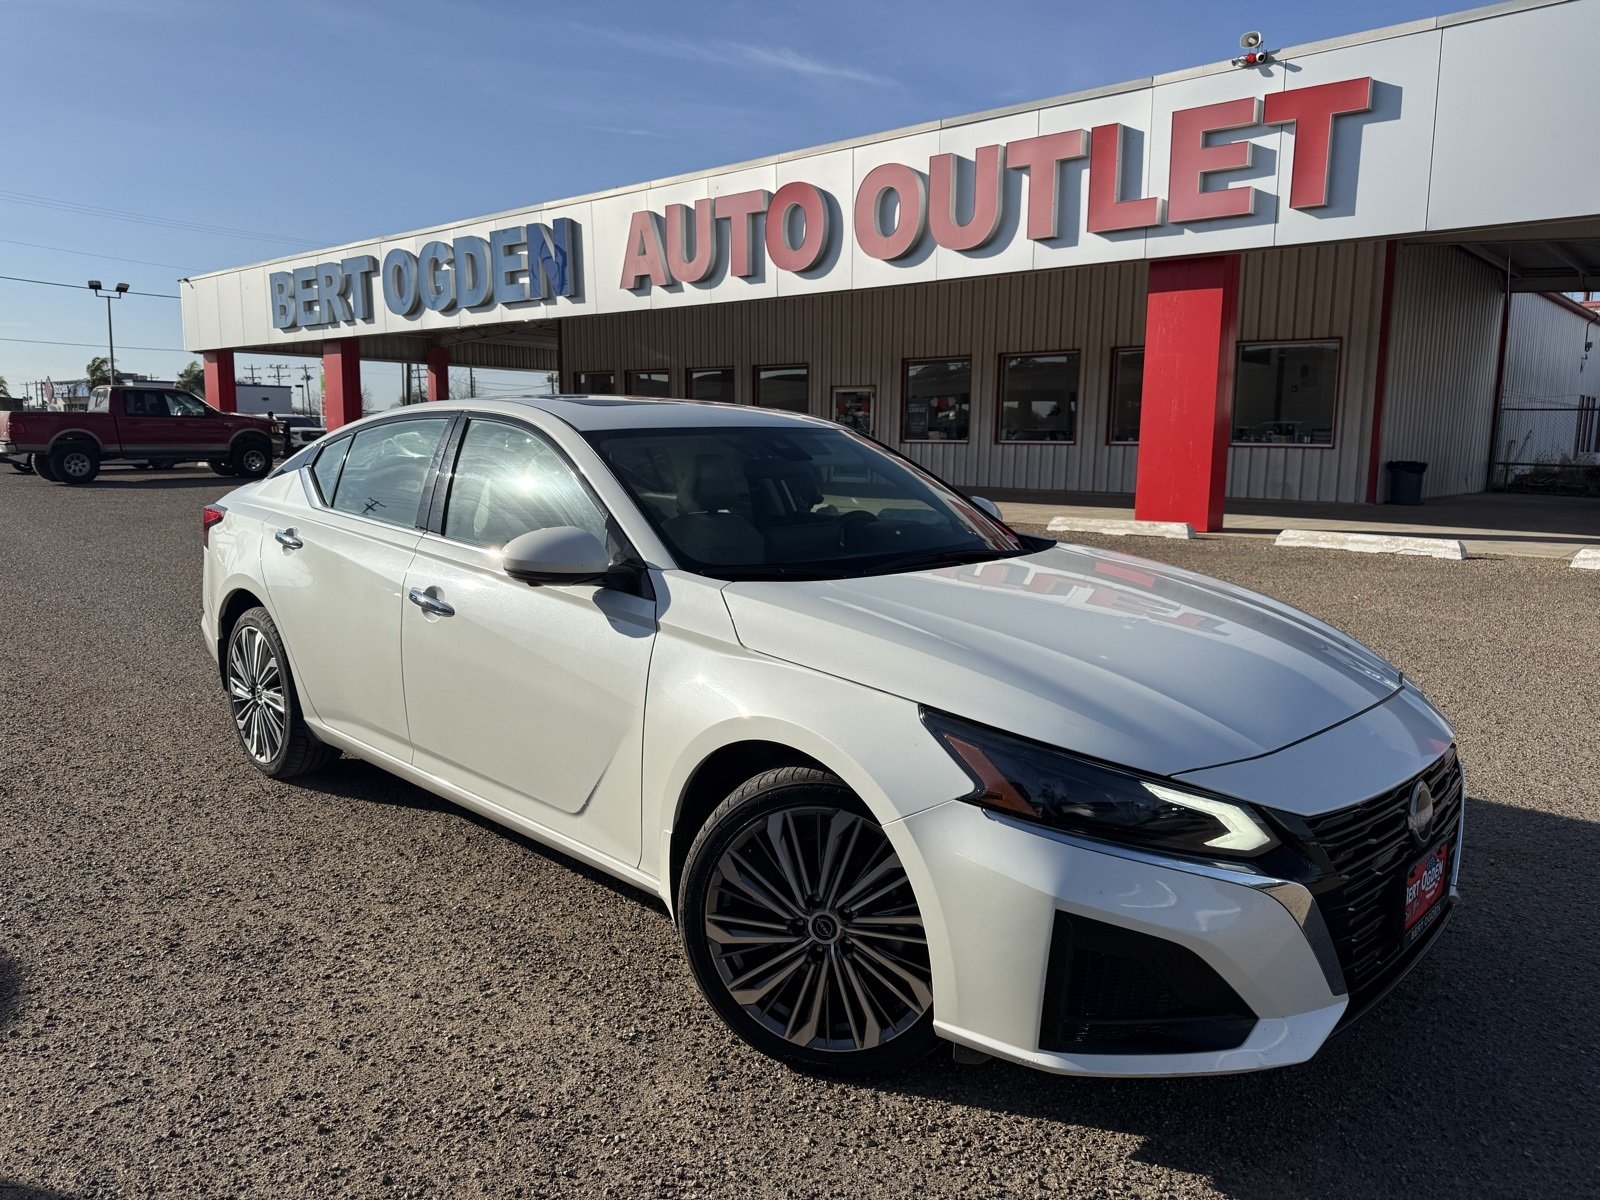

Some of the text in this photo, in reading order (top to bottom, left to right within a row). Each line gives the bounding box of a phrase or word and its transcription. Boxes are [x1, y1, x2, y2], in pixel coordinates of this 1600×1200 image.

[270, 76, 1374, 329] BERT OGDEN AUTO OUTLET
[1421, 860, 1443, 891] OGDEN
